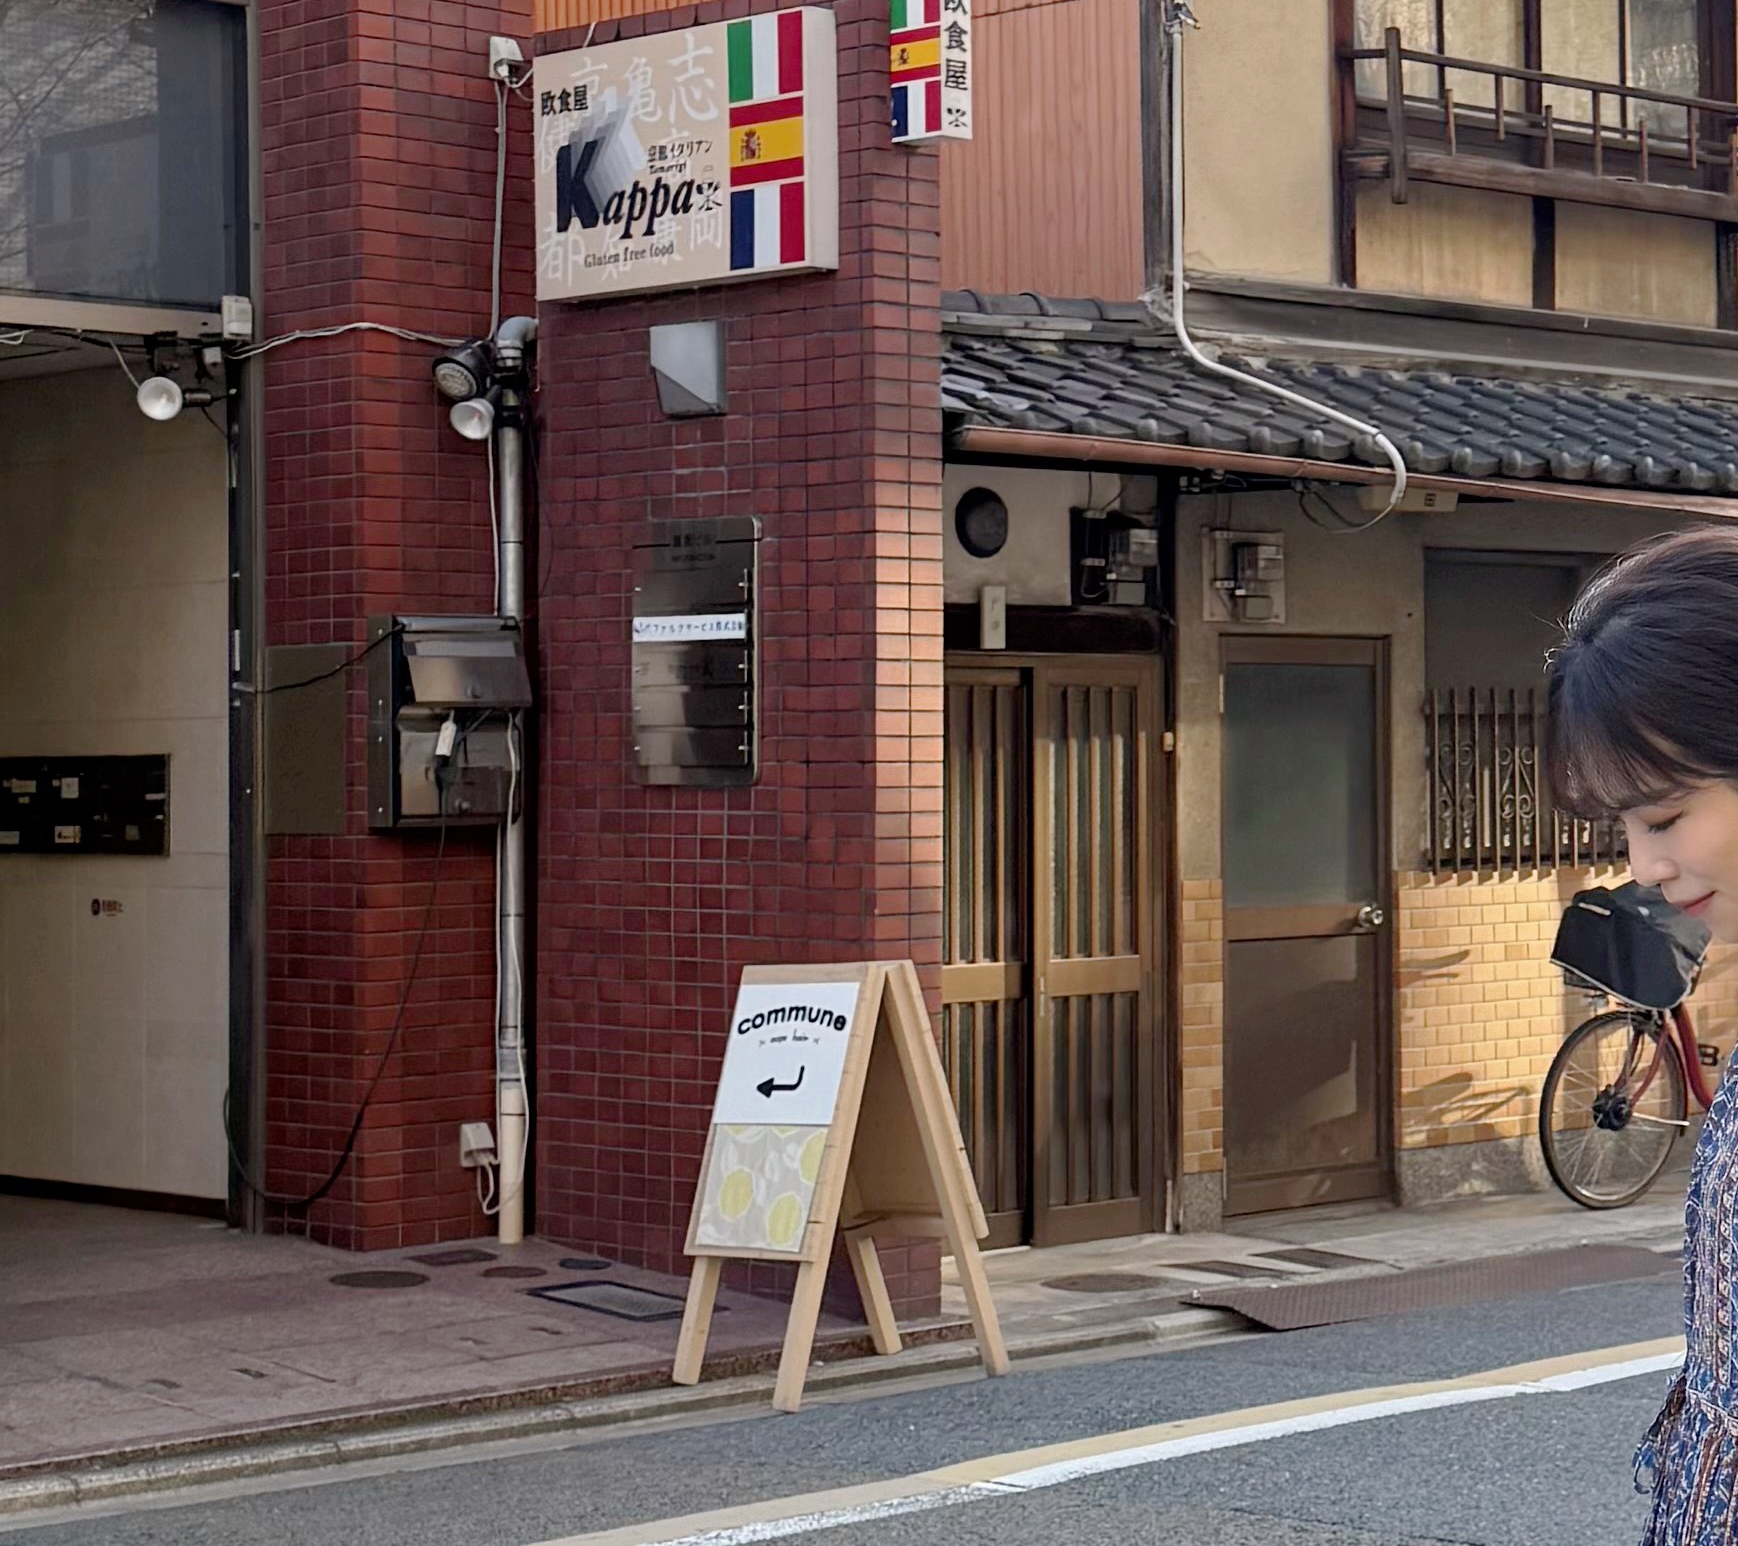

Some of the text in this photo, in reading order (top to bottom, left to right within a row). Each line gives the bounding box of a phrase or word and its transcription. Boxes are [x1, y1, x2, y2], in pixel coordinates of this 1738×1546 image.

[541, 84, 589, 116] 欧食屋
[556, 136, 695, 240] Kappa
[737, 1005, 847, 1035] commune
